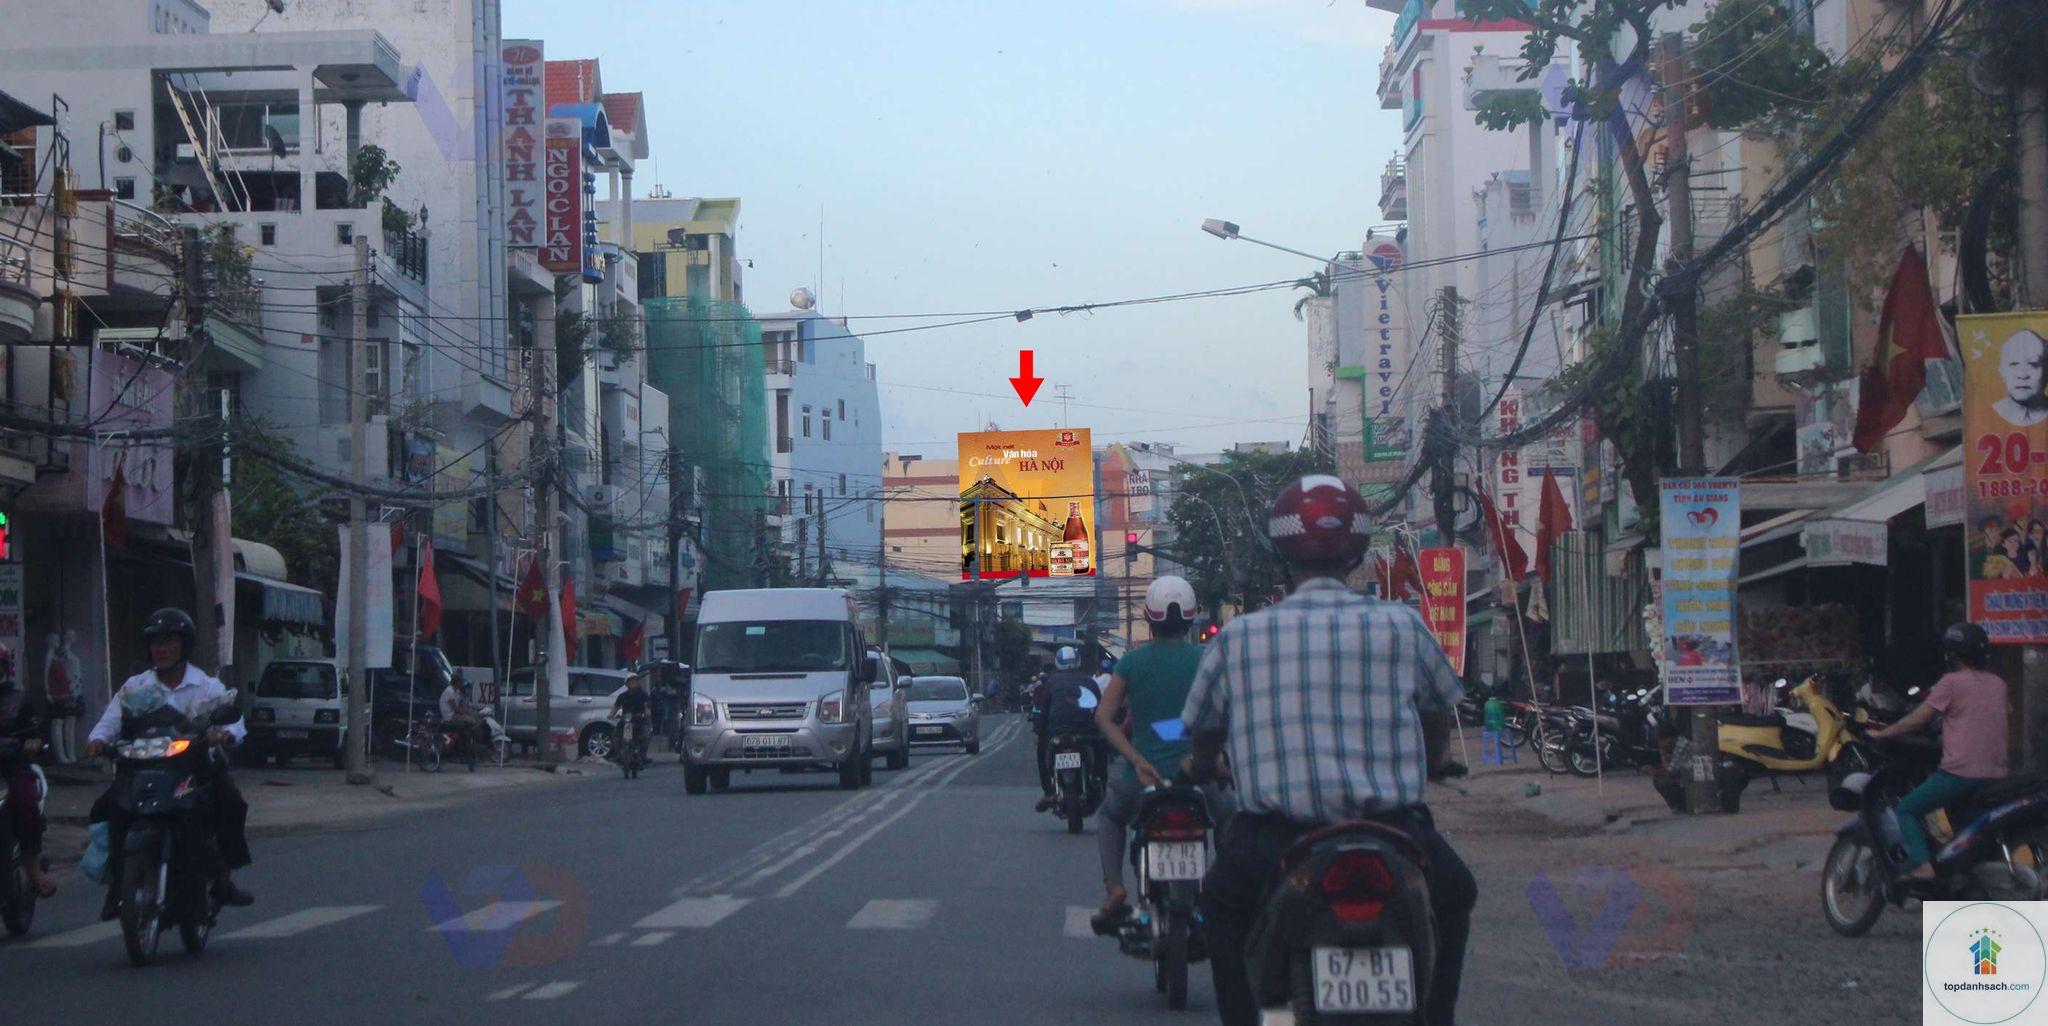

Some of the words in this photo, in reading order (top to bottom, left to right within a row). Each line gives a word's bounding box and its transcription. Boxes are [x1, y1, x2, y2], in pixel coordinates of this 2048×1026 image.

[505, 88, 536, 181] THANH
[547, 149, 570, 213] NGỌC
[507, 189, 538, 244] LAN
[549, 216, 572, 262] LAN
[1003, 450, 1020, 459] Văn
[1021, 448, 1038, 458] hóa
[1500, 399, 1519, 484] KHNG
[968, 454, 1012, 467] Culture
[1019, 458, 1038, 472] HÀ
[1041, 457, 1065, 473] NỘI
[1440, 606, 1456, 621] NAM
[1157, 861, 1197, 877] 9183
[1328, 949, 1394, 977] 67-B1
